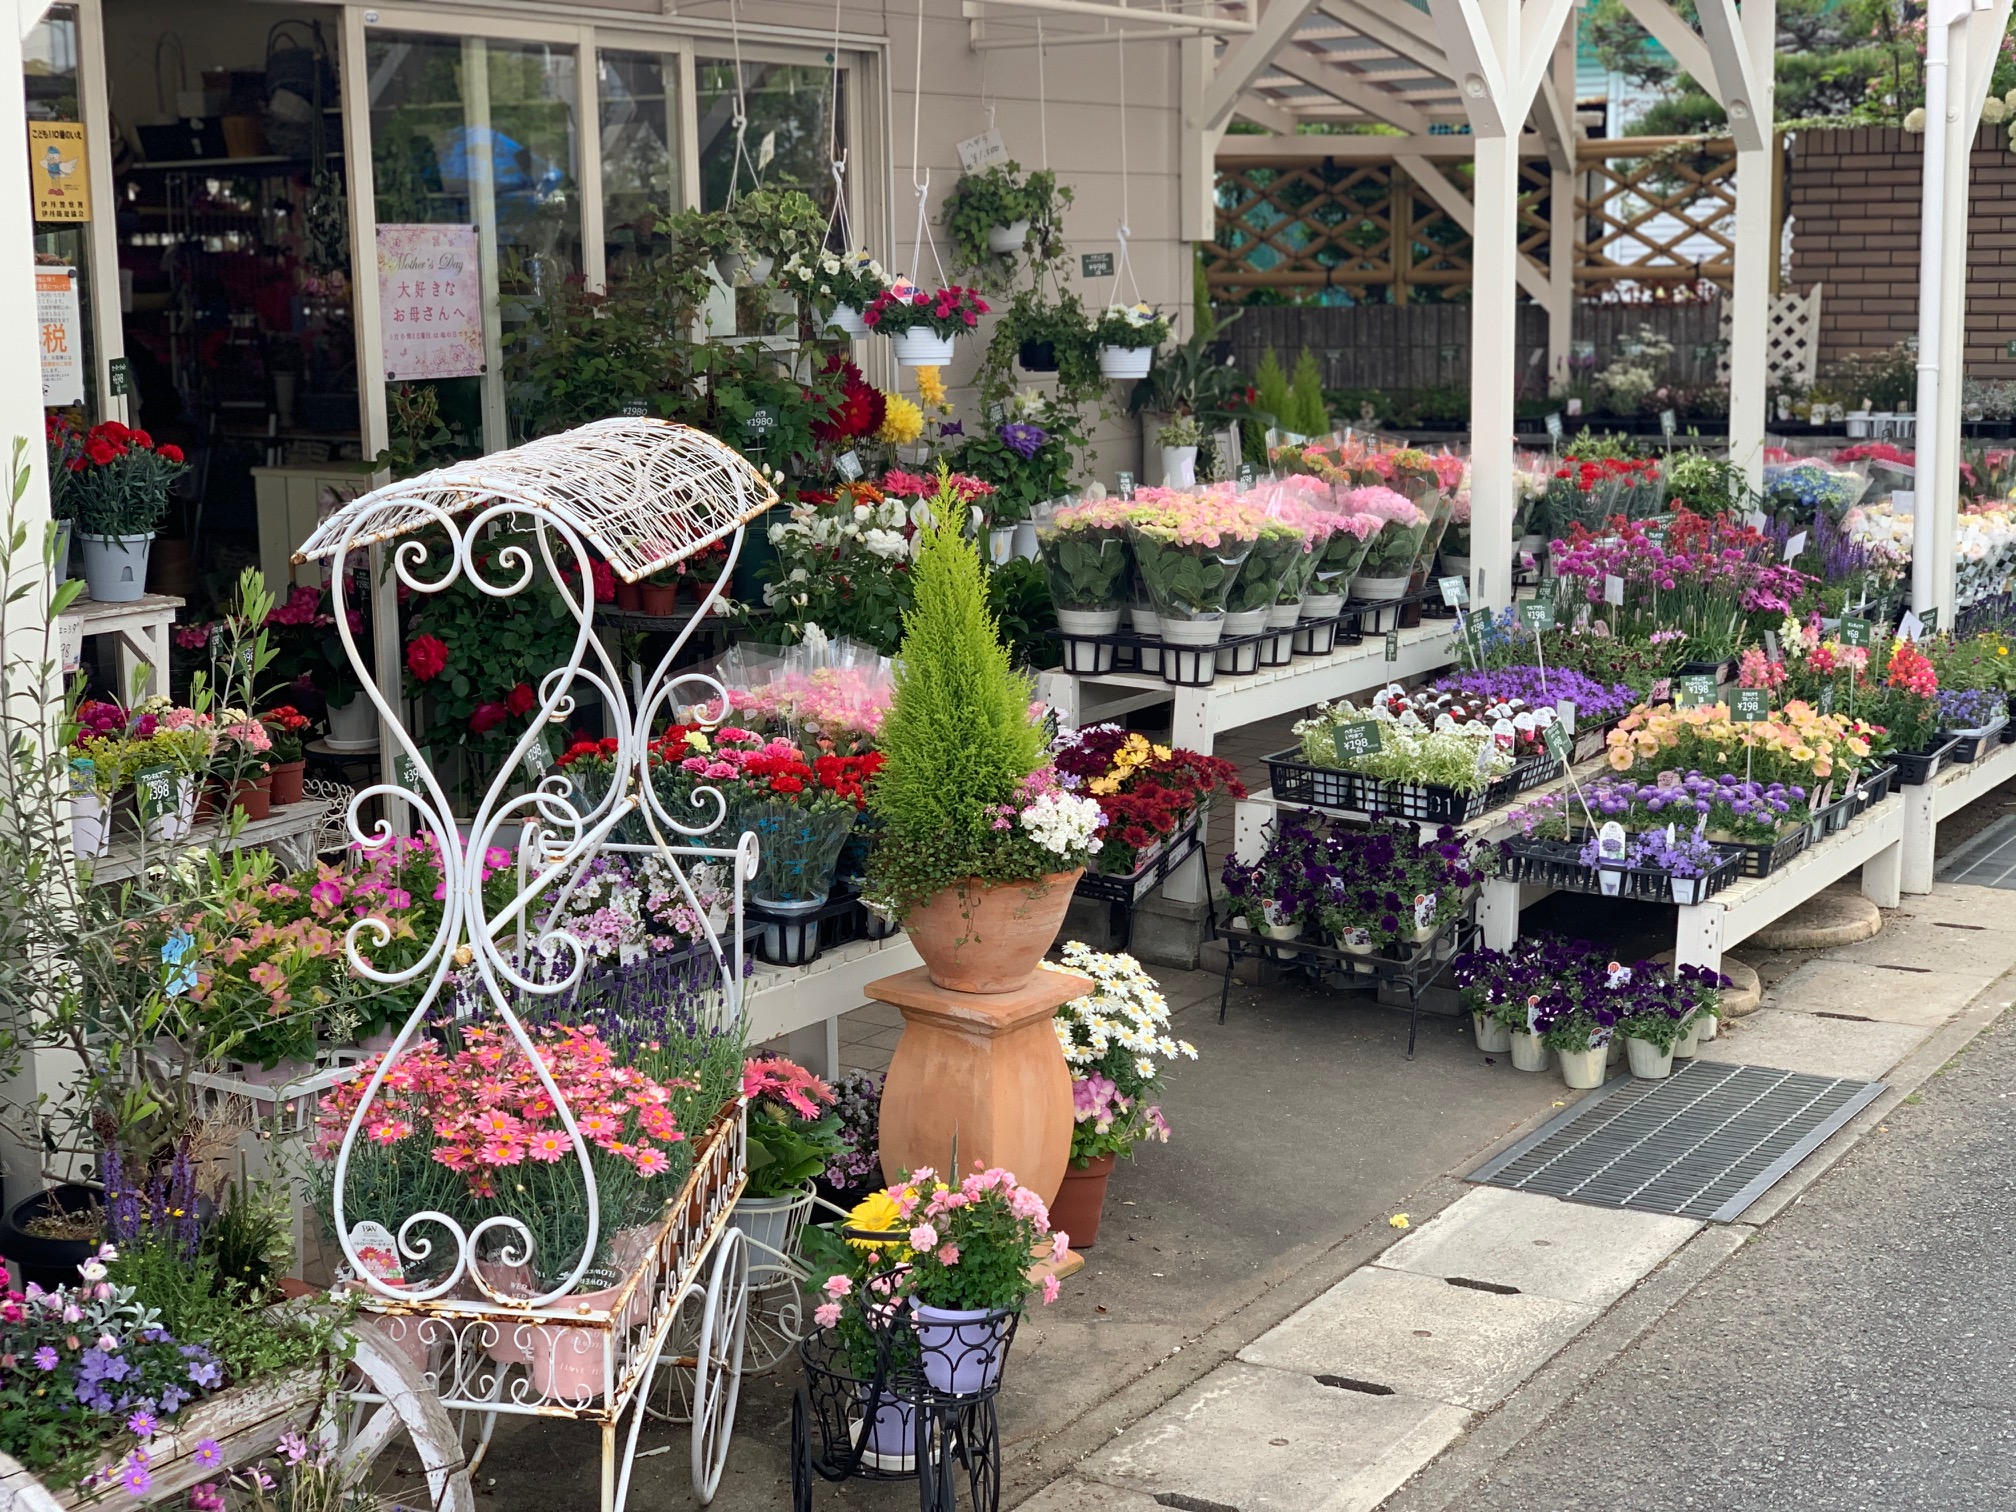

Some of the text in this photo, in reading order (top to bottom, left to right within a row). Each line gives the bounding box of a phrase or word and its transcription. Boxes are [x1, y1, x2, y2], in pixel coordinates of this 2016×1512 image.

[389, 252, 464, 276] Mother's Day
[397, 280, 455, 298] 大好きな
[393, 306, 465, 323] お母さんへ
[622, 406, 648, 416] ¥1980
[746, 416, 774, 427] ¥1980
[1527, 610, 1546, 620] ¥198
[1688, 685, 1709, 695] ¥198
[1737, 701, 1759, 712] ¥198
[1343, 737, 1369, 751] ¥198
[403, 767, 419, 783] ¥39
